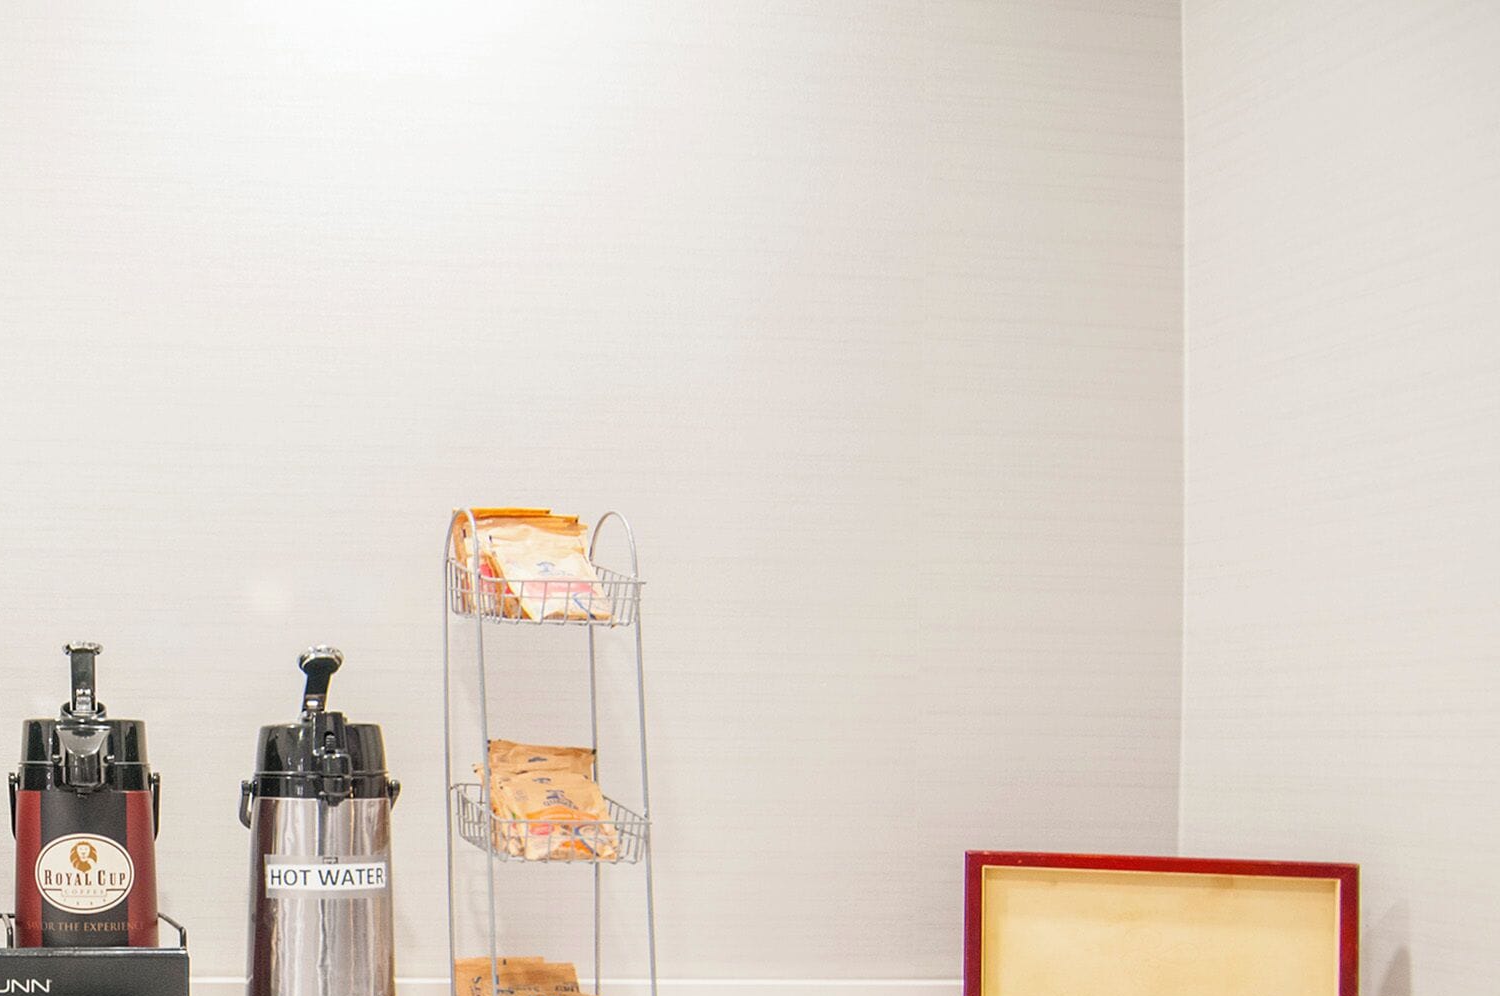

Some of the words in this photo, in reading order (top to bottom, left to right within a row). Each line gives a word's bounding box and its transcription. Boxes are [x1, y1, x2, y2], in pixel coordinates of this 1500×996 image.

[270, 869, 311, 886] HOT
[318, 867, 384, 886] WATER
[58, 921, 79, 931] THE
